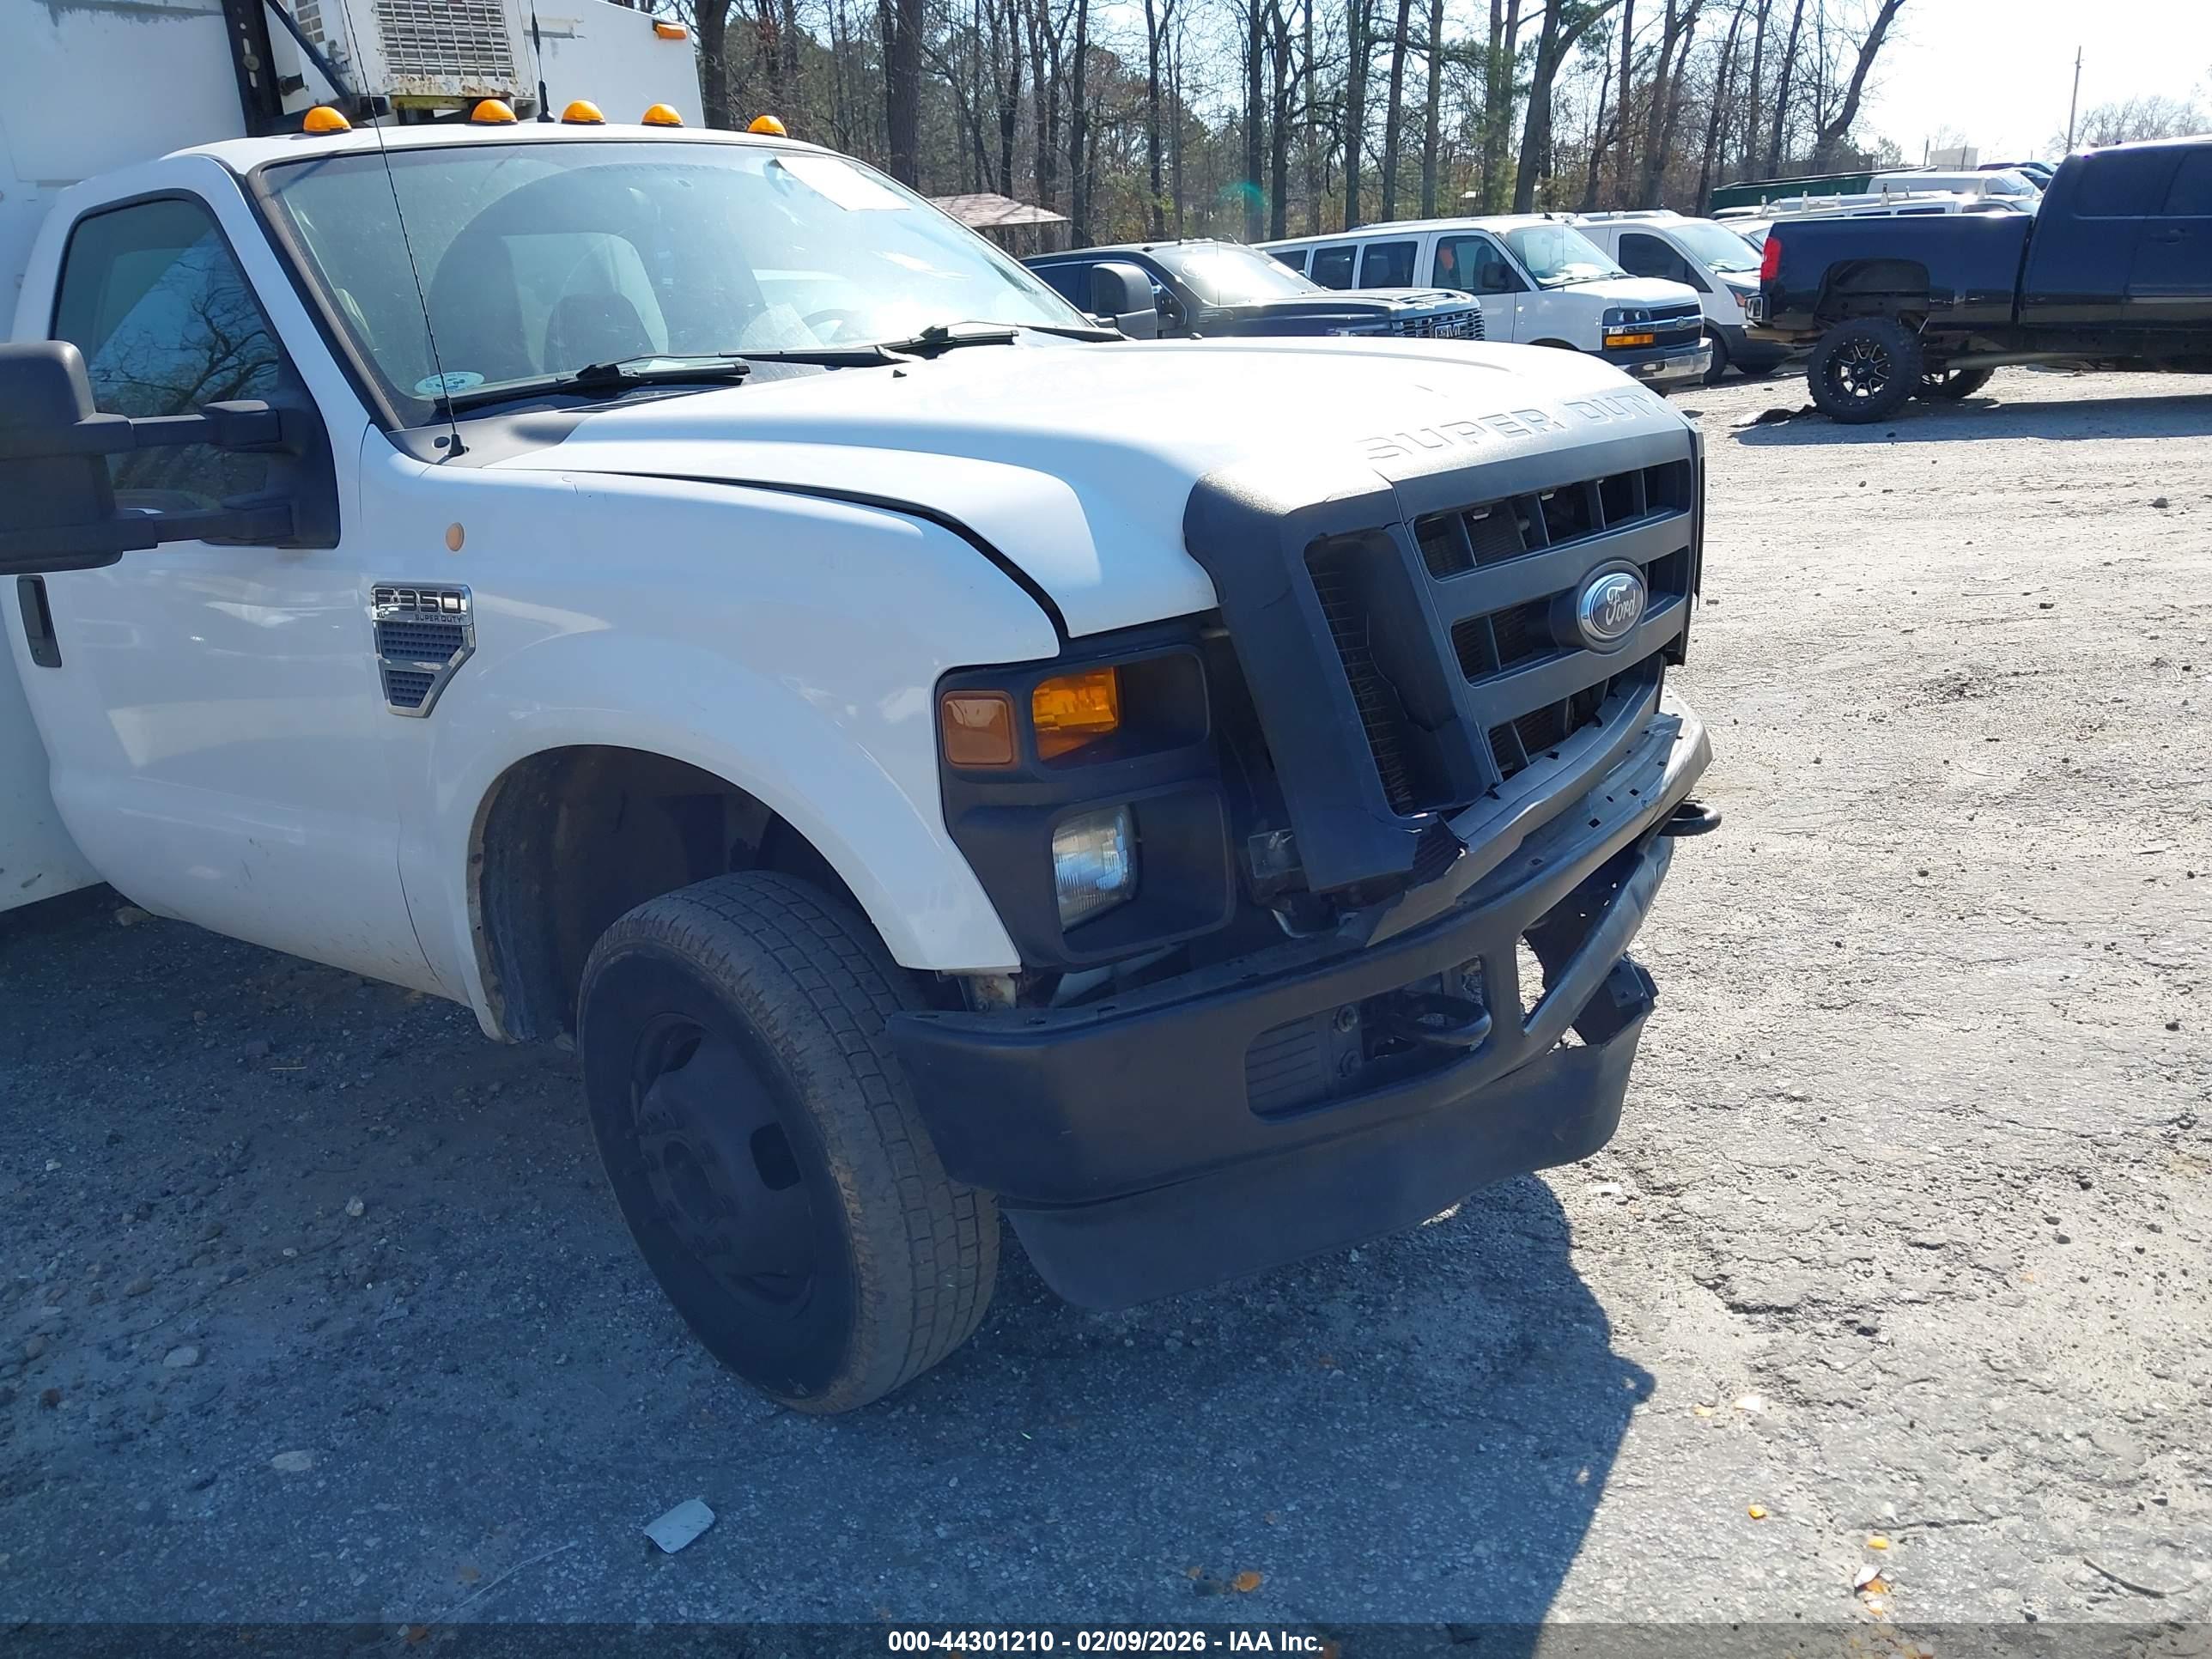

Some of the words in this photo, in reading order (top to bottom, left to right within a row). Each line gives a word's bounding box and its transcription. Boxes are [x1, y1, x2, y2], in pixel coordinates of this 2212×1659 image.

[1353, 409, 1565, 459] SUPER
[1564, 393, 1668, 424] DUTY
[1605, 584, 1636, 626] Ford
